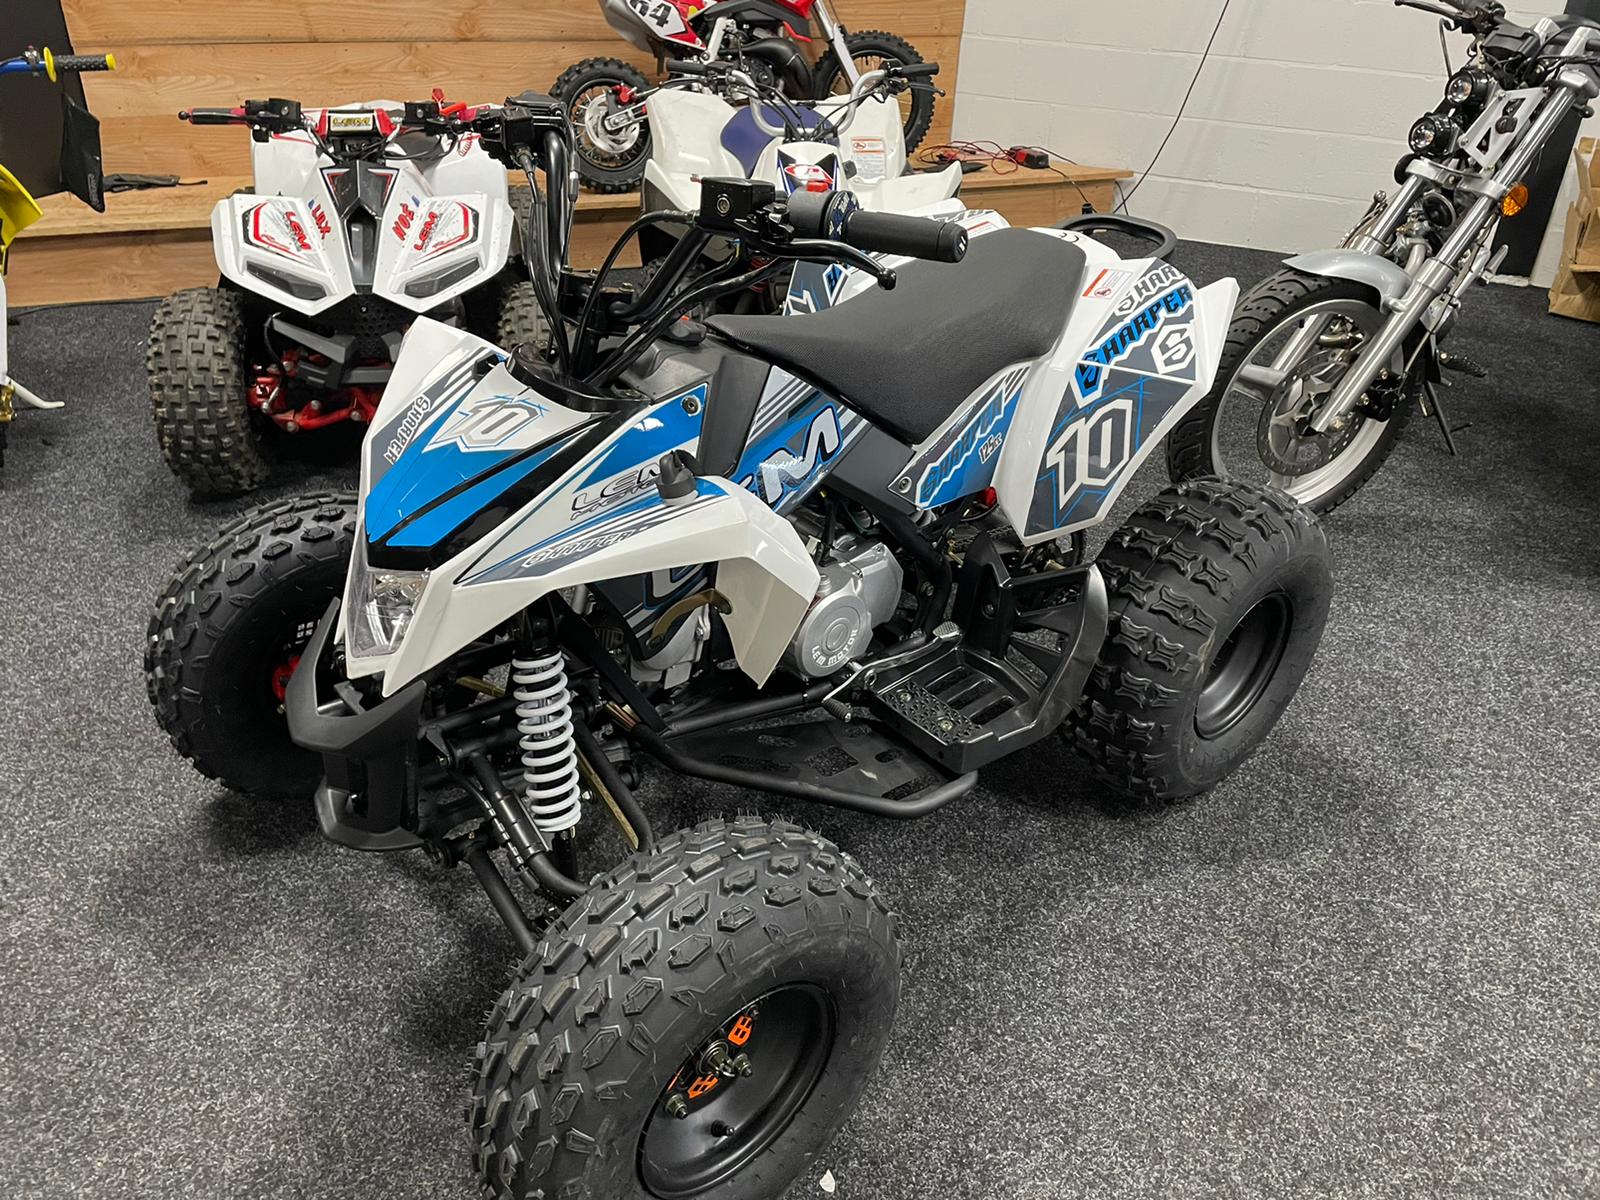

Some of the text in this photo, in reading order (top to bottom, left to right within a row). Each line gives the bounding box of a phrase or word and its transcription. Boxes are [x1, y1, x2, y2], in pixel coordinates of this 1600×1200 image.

[284, 211, 312, 250] LEM
[414, 211, 438, 251] LEM
[1075, 283, 1194, 392] SHARPER
[384, 395, 430, 465] SHARPER
[434, 400, 541, 448] 10
[1046, 399, 1133, 510] 10
[812, 645, 827, 666] LEM
